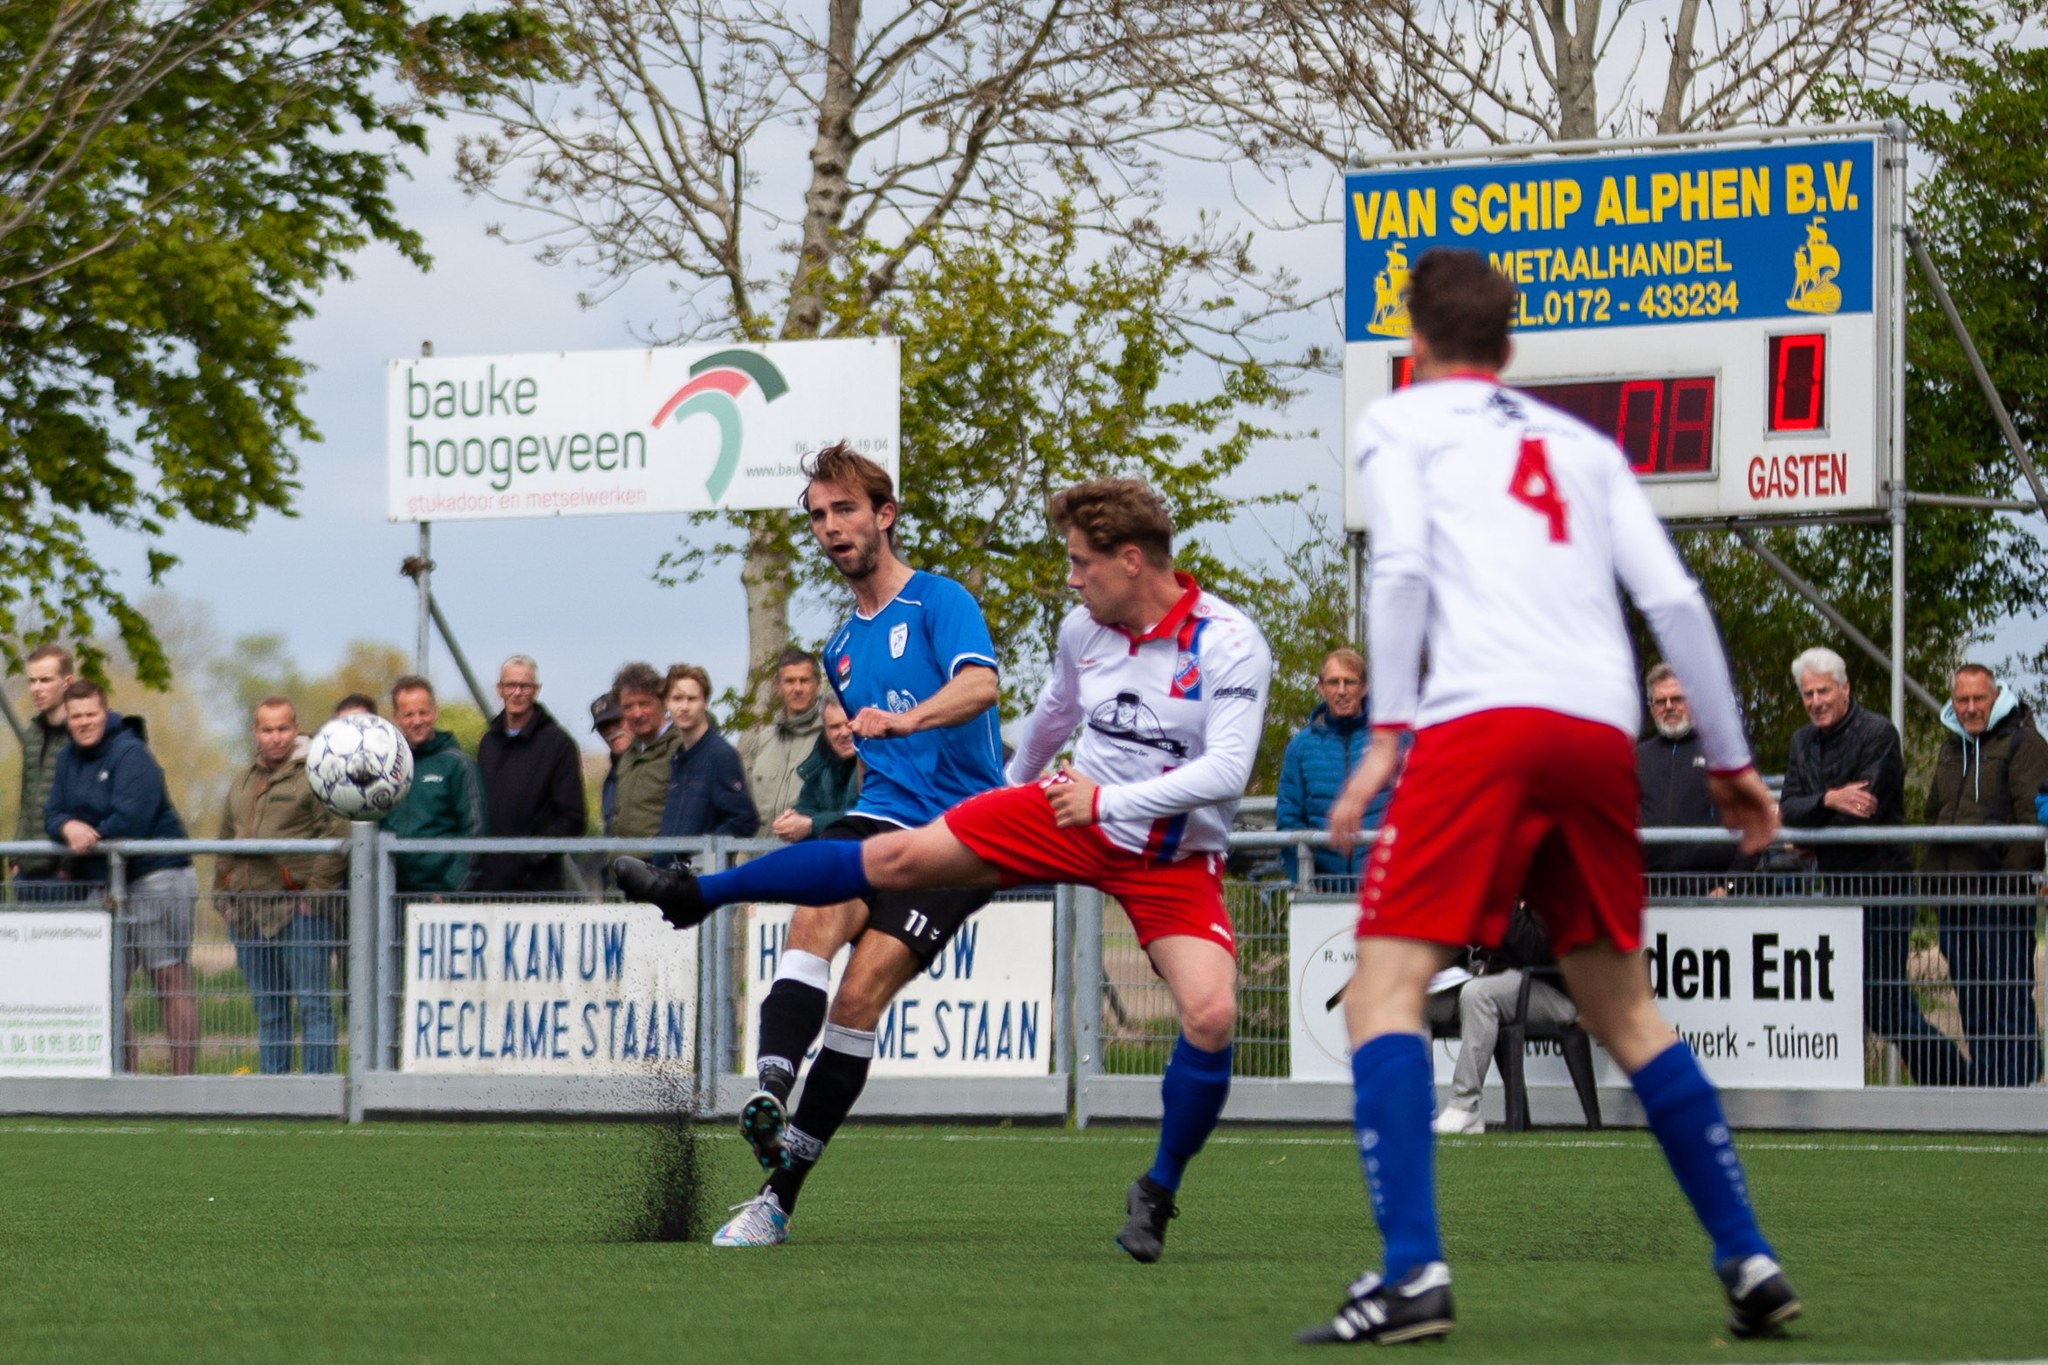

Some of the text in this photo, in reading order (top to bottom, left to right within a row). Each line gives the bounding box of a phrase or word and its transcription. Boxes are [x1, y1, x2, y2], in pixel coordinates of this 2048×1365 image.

[1353, 160, 1859, 241] VAN SCHIP ALPHEN B.V.
[1488, 238, 1733, 284] METAALHANDEL
[1638, 281, 1739, 319] 433234
[407, 363, 538, 420] bauke
[1774, 333, 1824, 432] 0
[407, 425, 647, 491] hoogeveen
[1748, 453, 1847, 501] GASTEN
[408, 487, 647, 514] stukadoor en metselwerken
[1508, 438, 1572, 544] 4
[417, 922, 627, 982] HIER KAN UW
[760, 923, 788, 981] HI
[904, 909, 928, 937] 11
[1645, 932, 1835, 1001] den Ent
[415, 999, 686, 1060] RECLAME STAAN
[933, 1000, 1040, 1060] STAAN
[1763, 1024, 1839, 1060] Tuinen
